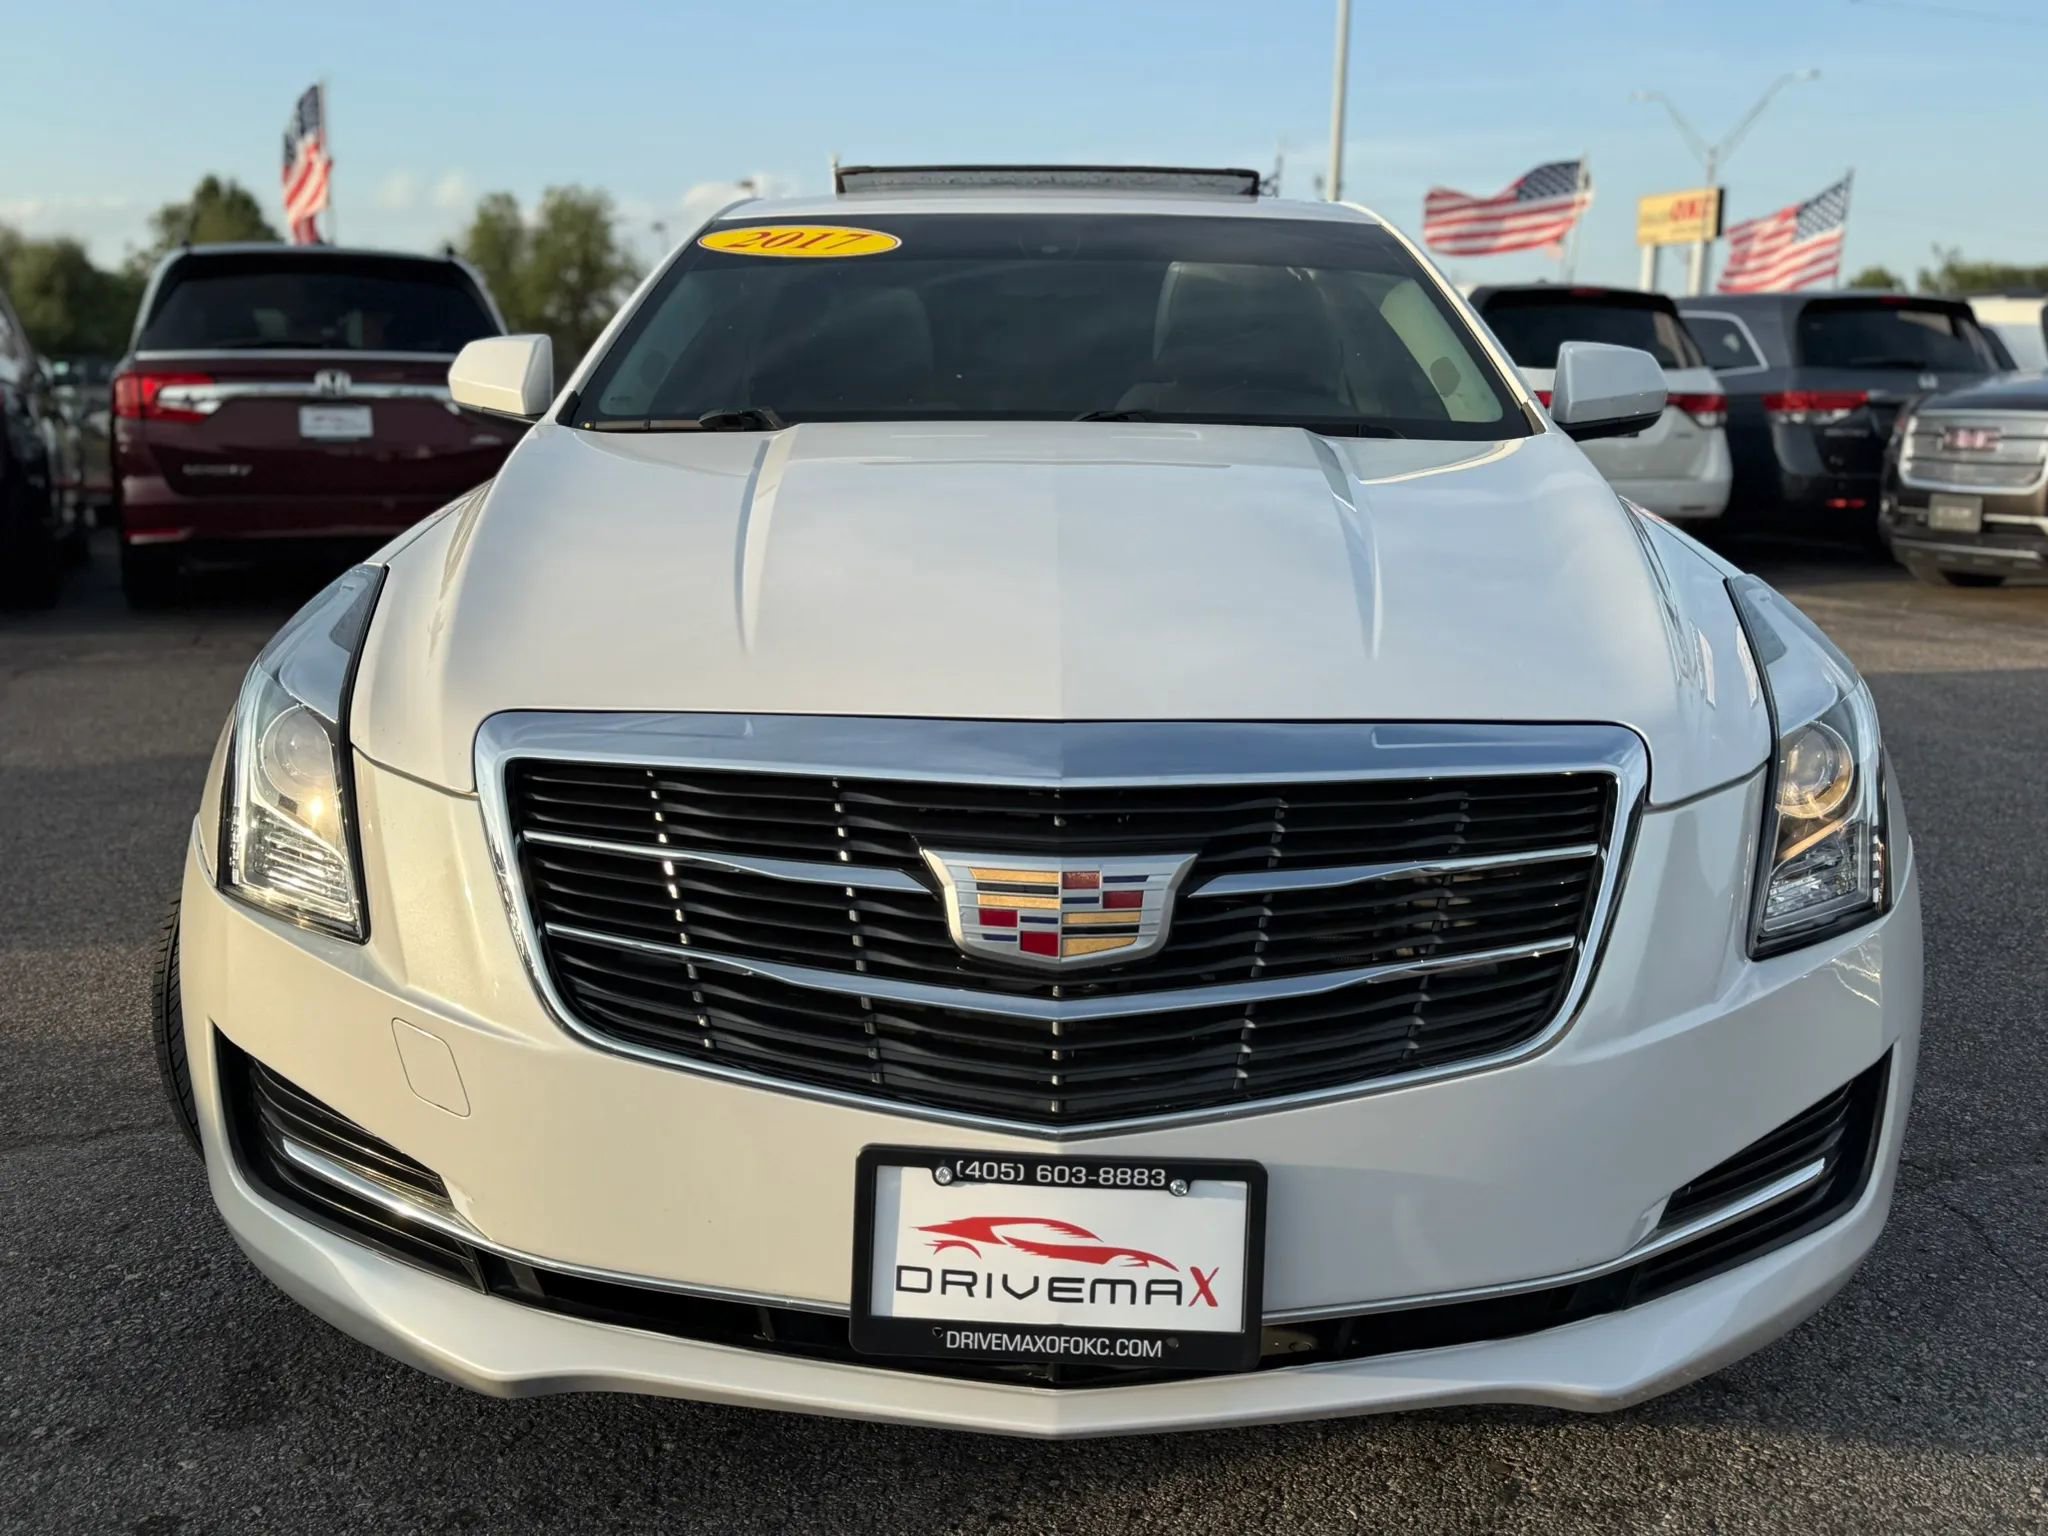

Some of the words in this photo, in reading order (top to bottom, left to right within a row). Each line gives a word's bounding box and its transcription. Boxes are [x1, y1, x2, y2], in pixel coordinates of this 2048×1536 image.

[724, 231, 873, 250] 2017
[956, 1160, 1025, 1182] (405)
[1036, 1165, 1166, 1187] 603-8883
[896, 1265, 1219, 1307] DRIVEMAX
[946, 1331, 1162, 1358] DRIVEMAXOFOKC.COM
